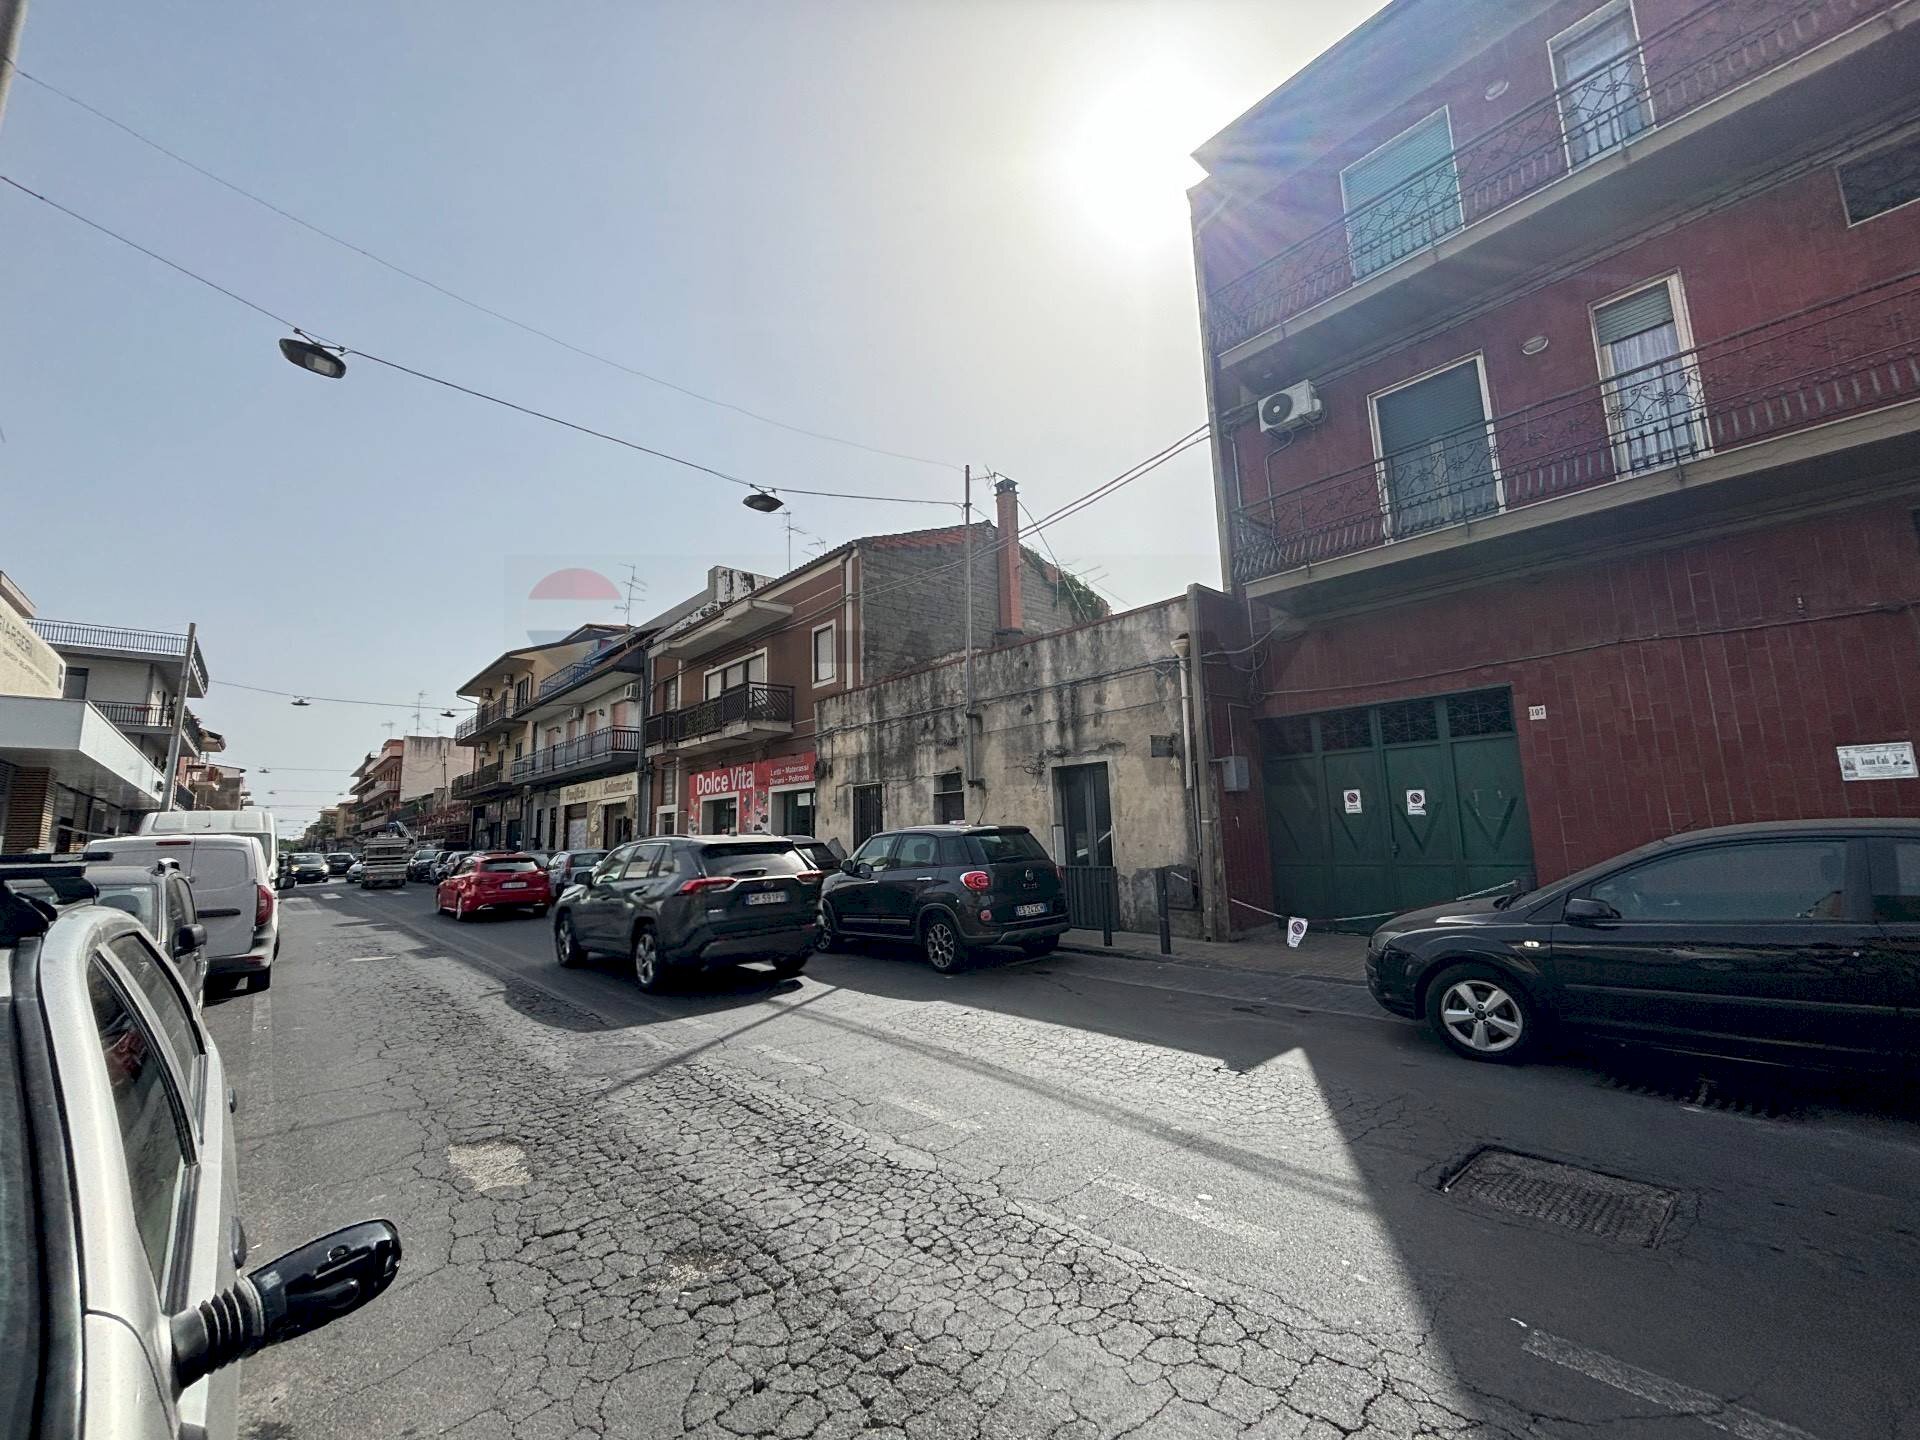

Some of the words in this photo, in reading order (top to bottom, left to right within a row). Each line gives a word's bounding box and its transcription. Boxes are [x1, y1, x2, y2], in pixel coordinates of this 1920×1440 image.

[1531, 708, 1544, 716] 107
[697, 772, 728, 795] Dolce
[730, 767, 753, 790] Vita
